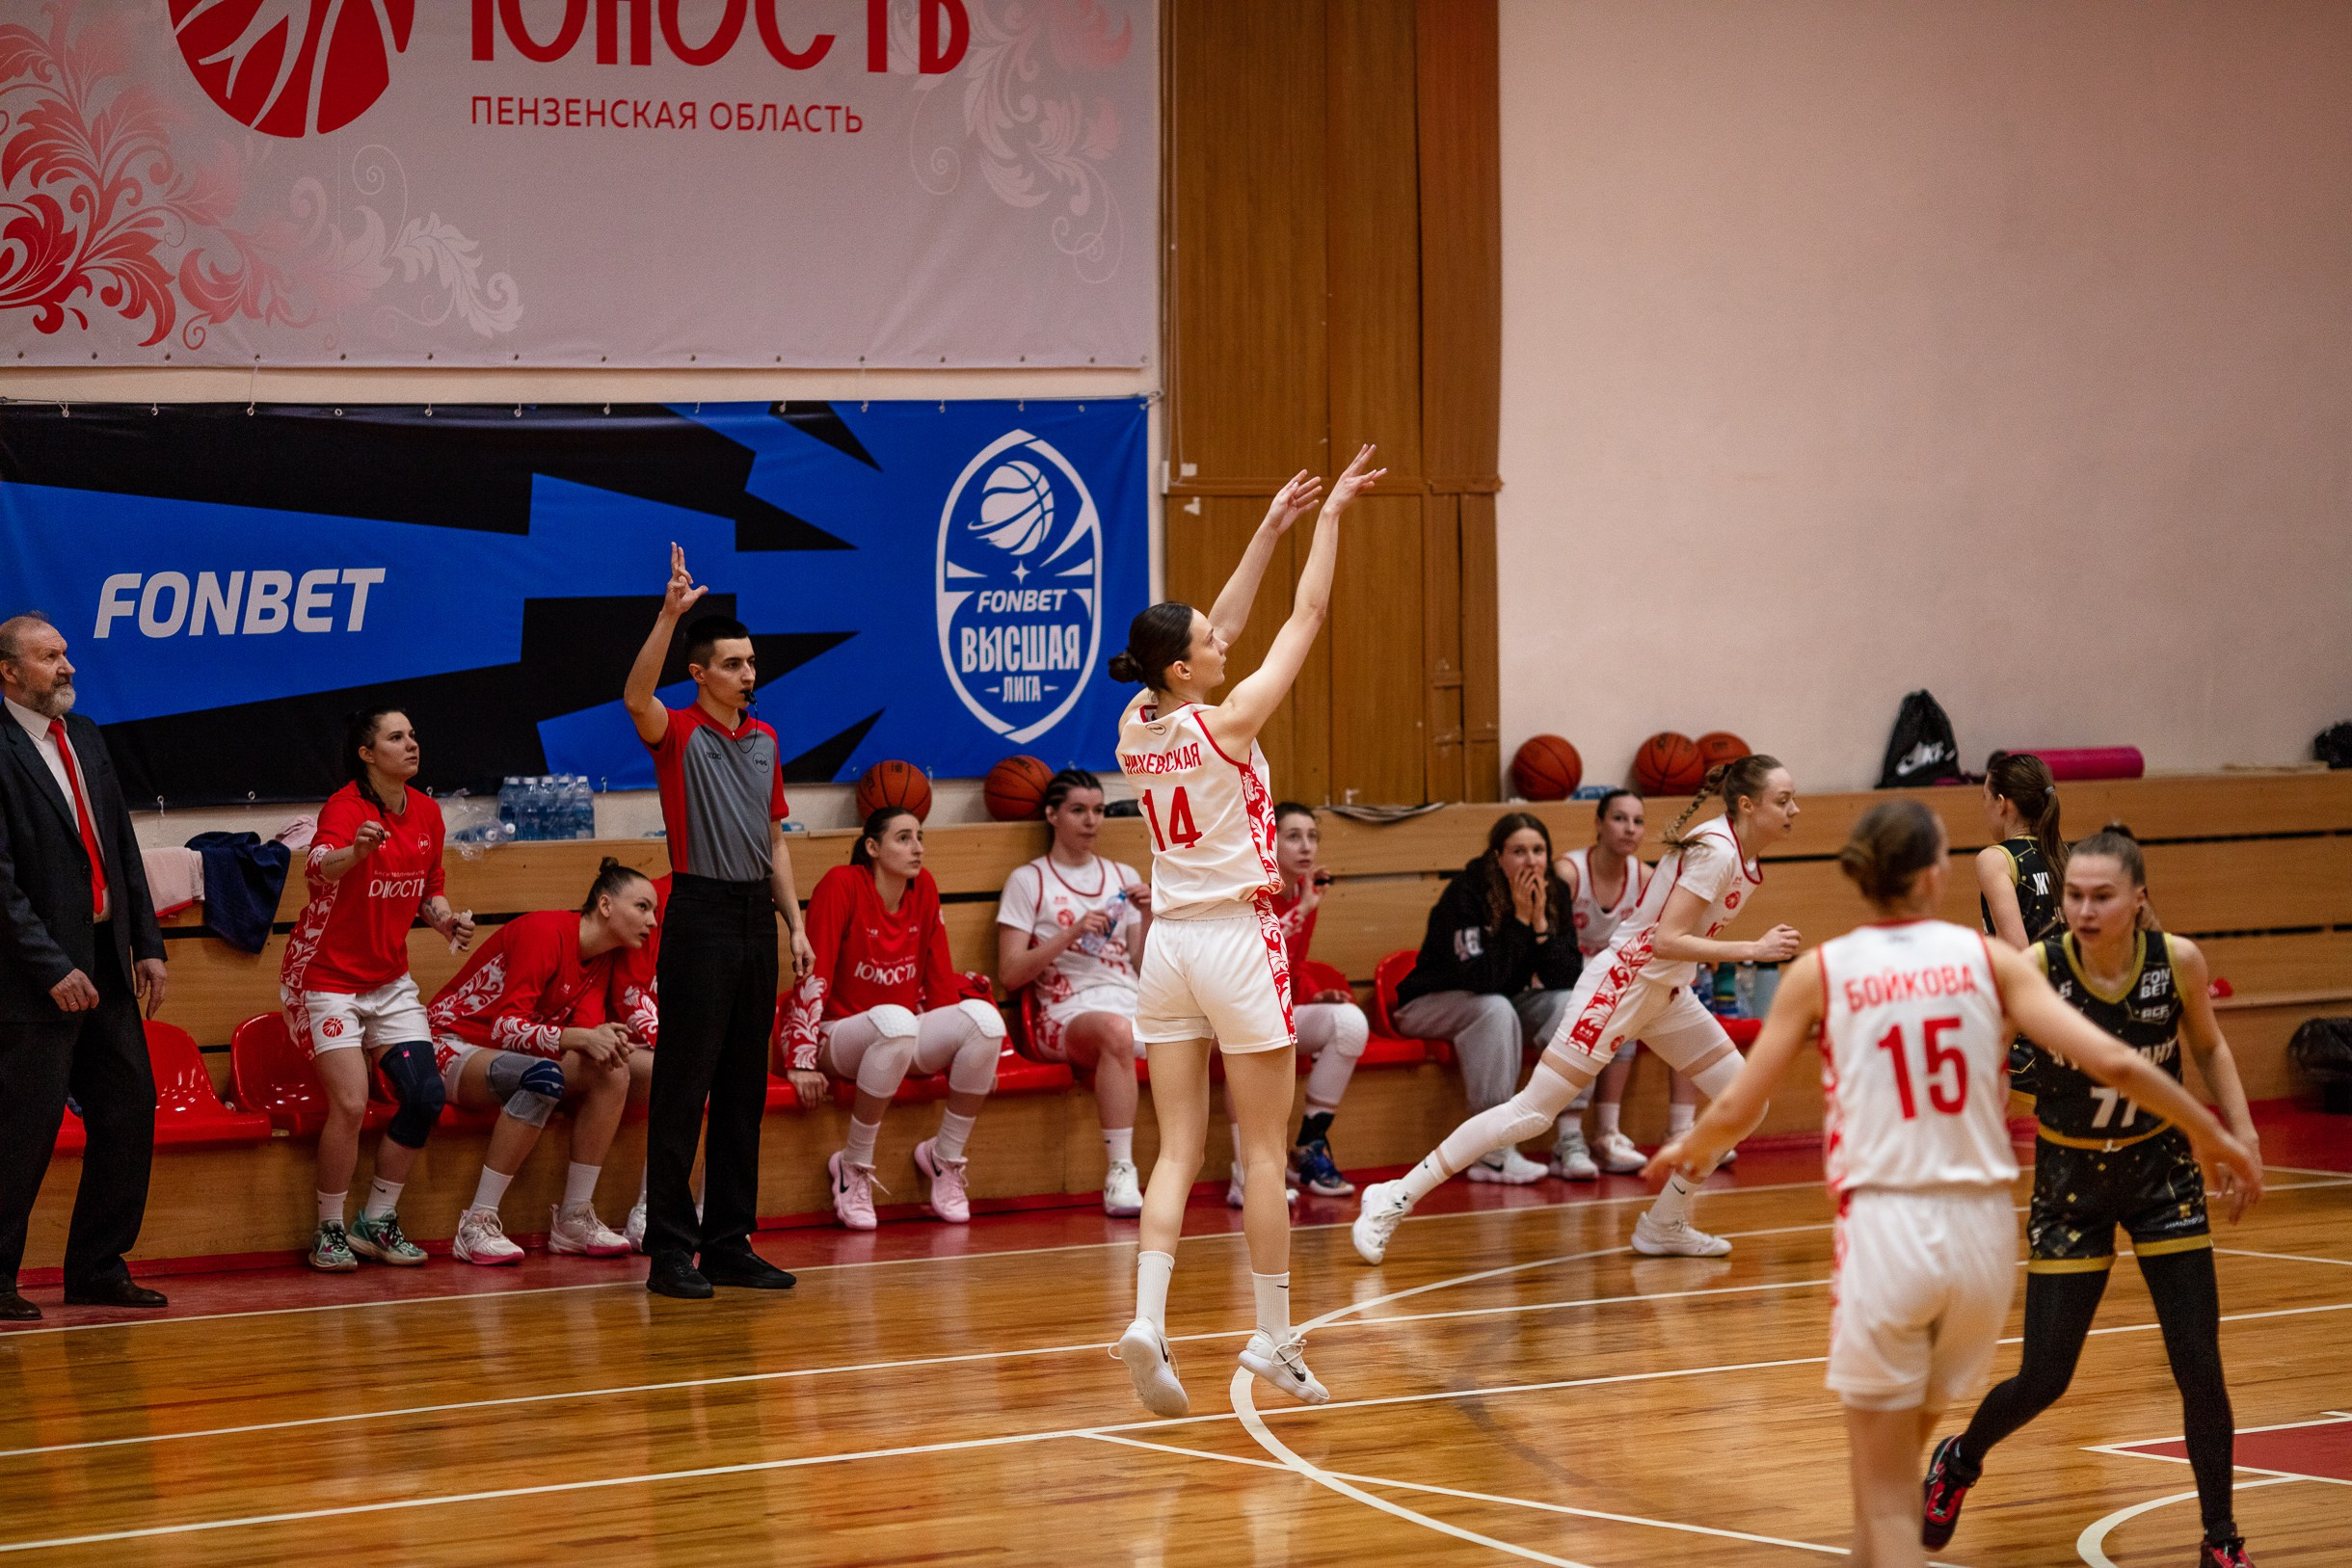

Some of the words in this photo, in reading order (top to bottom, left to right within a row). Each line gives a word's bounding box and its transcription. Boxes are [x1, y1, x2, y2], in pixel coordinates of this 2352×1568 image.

[470, 95, 698, 130] ПЕНЗЕНСКАЯ
[708, 101, 864, 134] ОБЛАСТЬ
[93, 567, 387, 639] FONBET
[976, 589, 1069, 614] FONBET
[960, 624, 1081, 673] ВЫСШАЯ
[1002, 675, 1042, 703] ЛИГА
[1141, 785, 1204, 852] 14
[1843, 964, 1979, 1015] БОЙКОВА
[2139, 981, 2170, 999] BET
[2141, 968, 2171, 985] FON
[1876, 1016, 1969, 1122] 15
